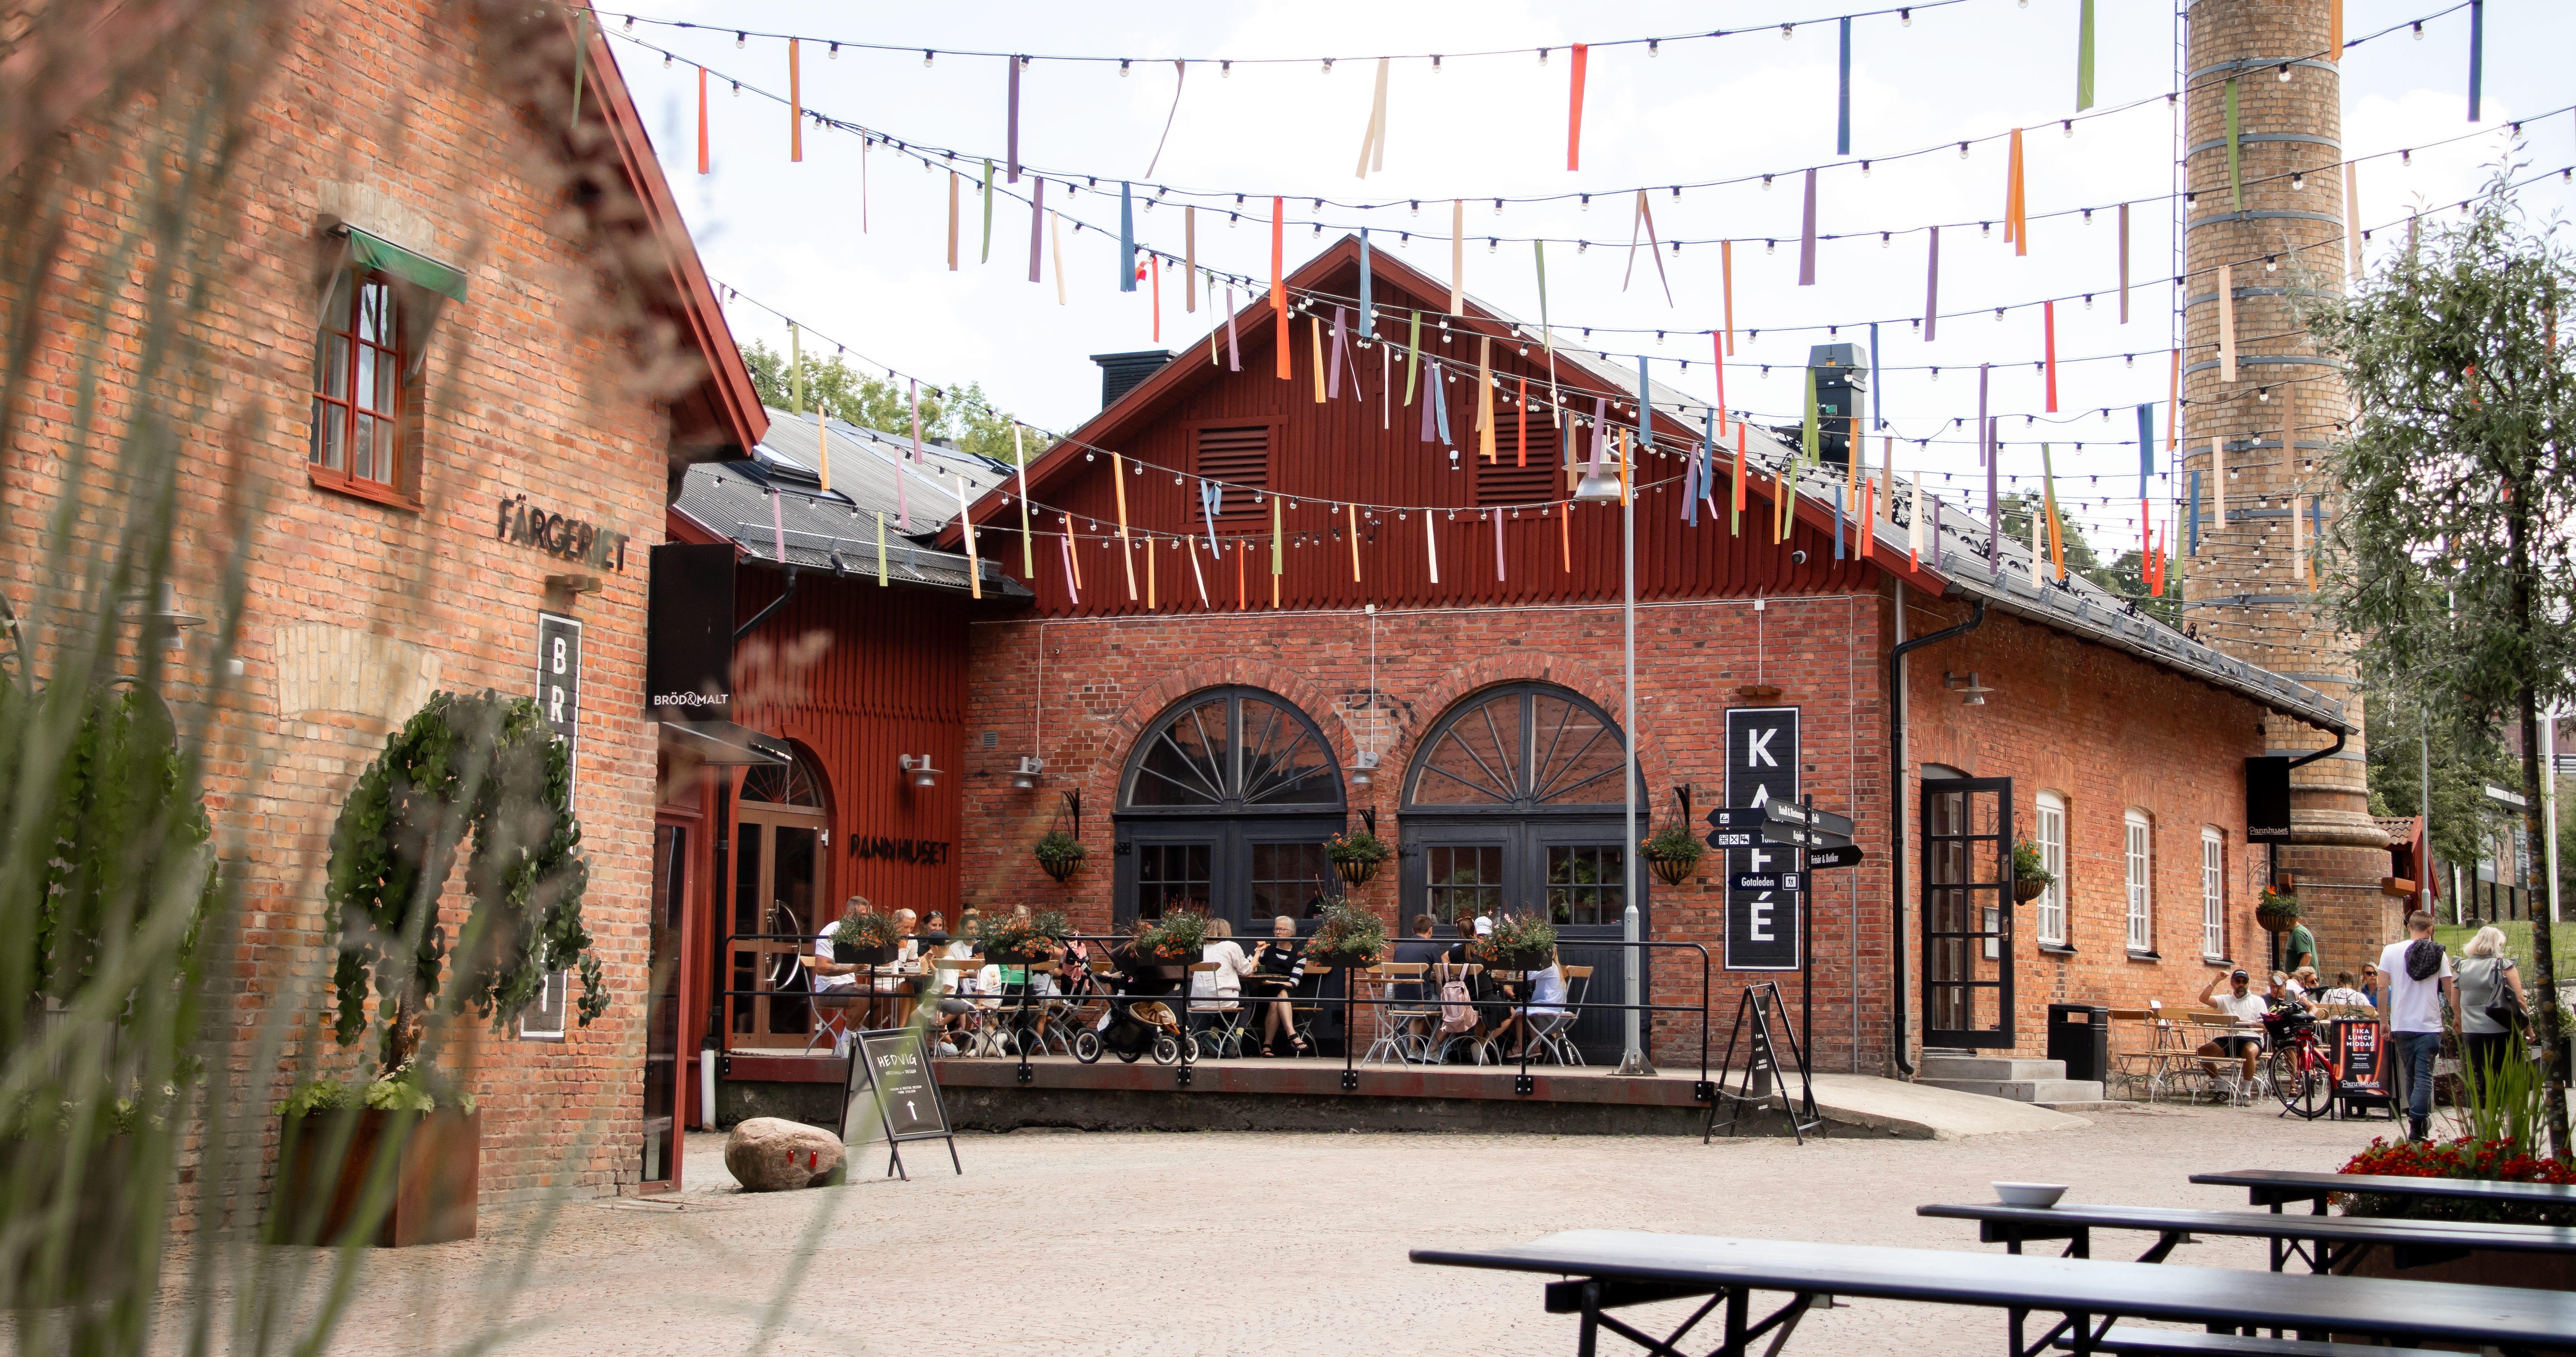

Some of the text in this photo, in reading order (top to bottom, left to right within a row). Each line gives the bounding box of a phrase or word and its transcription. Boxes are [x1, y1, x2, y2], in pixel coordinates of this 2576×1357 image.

[498, 493, 630, 571] FÄRGERIET
[654, 691, 728, 707] BRÖD&MALT
[1778, 805, 1788, 816] Hotell
[1787, 808, 1791, 816] &
[1790, 808, 1805, 822] Restaurang
[1793, 830, 1804, 842] Kajplats
[2248, 826, 2288, 835] Pannhuset
[850, 833, 950, 865] PANNHUSET
[1811, 852, 1838, 864] Frisör & Butiker
[1742, 876, 1774, 886] Gotaleden
[877, 1053, 917, 1067] HEDVIG
